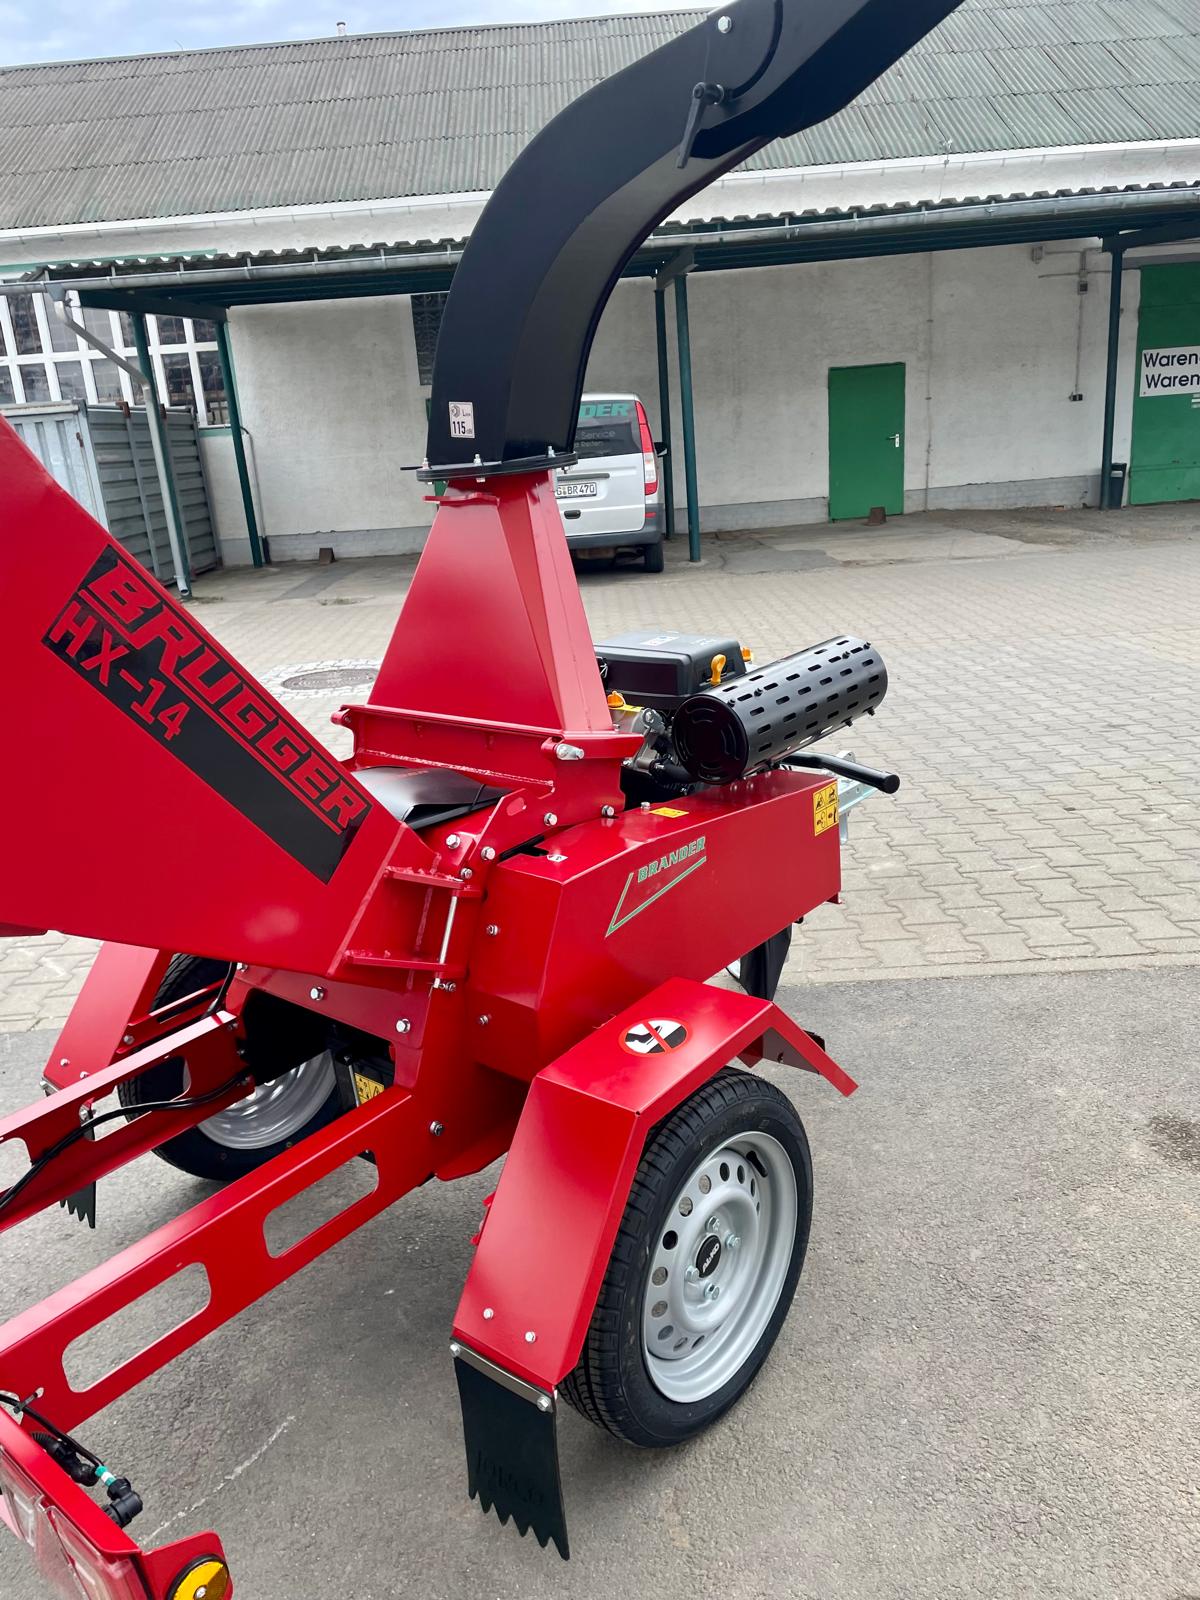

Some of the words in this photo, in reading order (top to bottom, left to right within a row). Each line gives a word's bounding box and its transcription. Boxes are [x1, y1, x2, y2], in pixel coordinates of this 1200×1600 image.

[1143, 352, 1200, 368] Waren
[452, 421, 466, 435] 115
[50, 601, 190, 741] HX-14
[87, 559, 370, 829] BRUGGER
[638, 836, 706, 883] BRANDER
